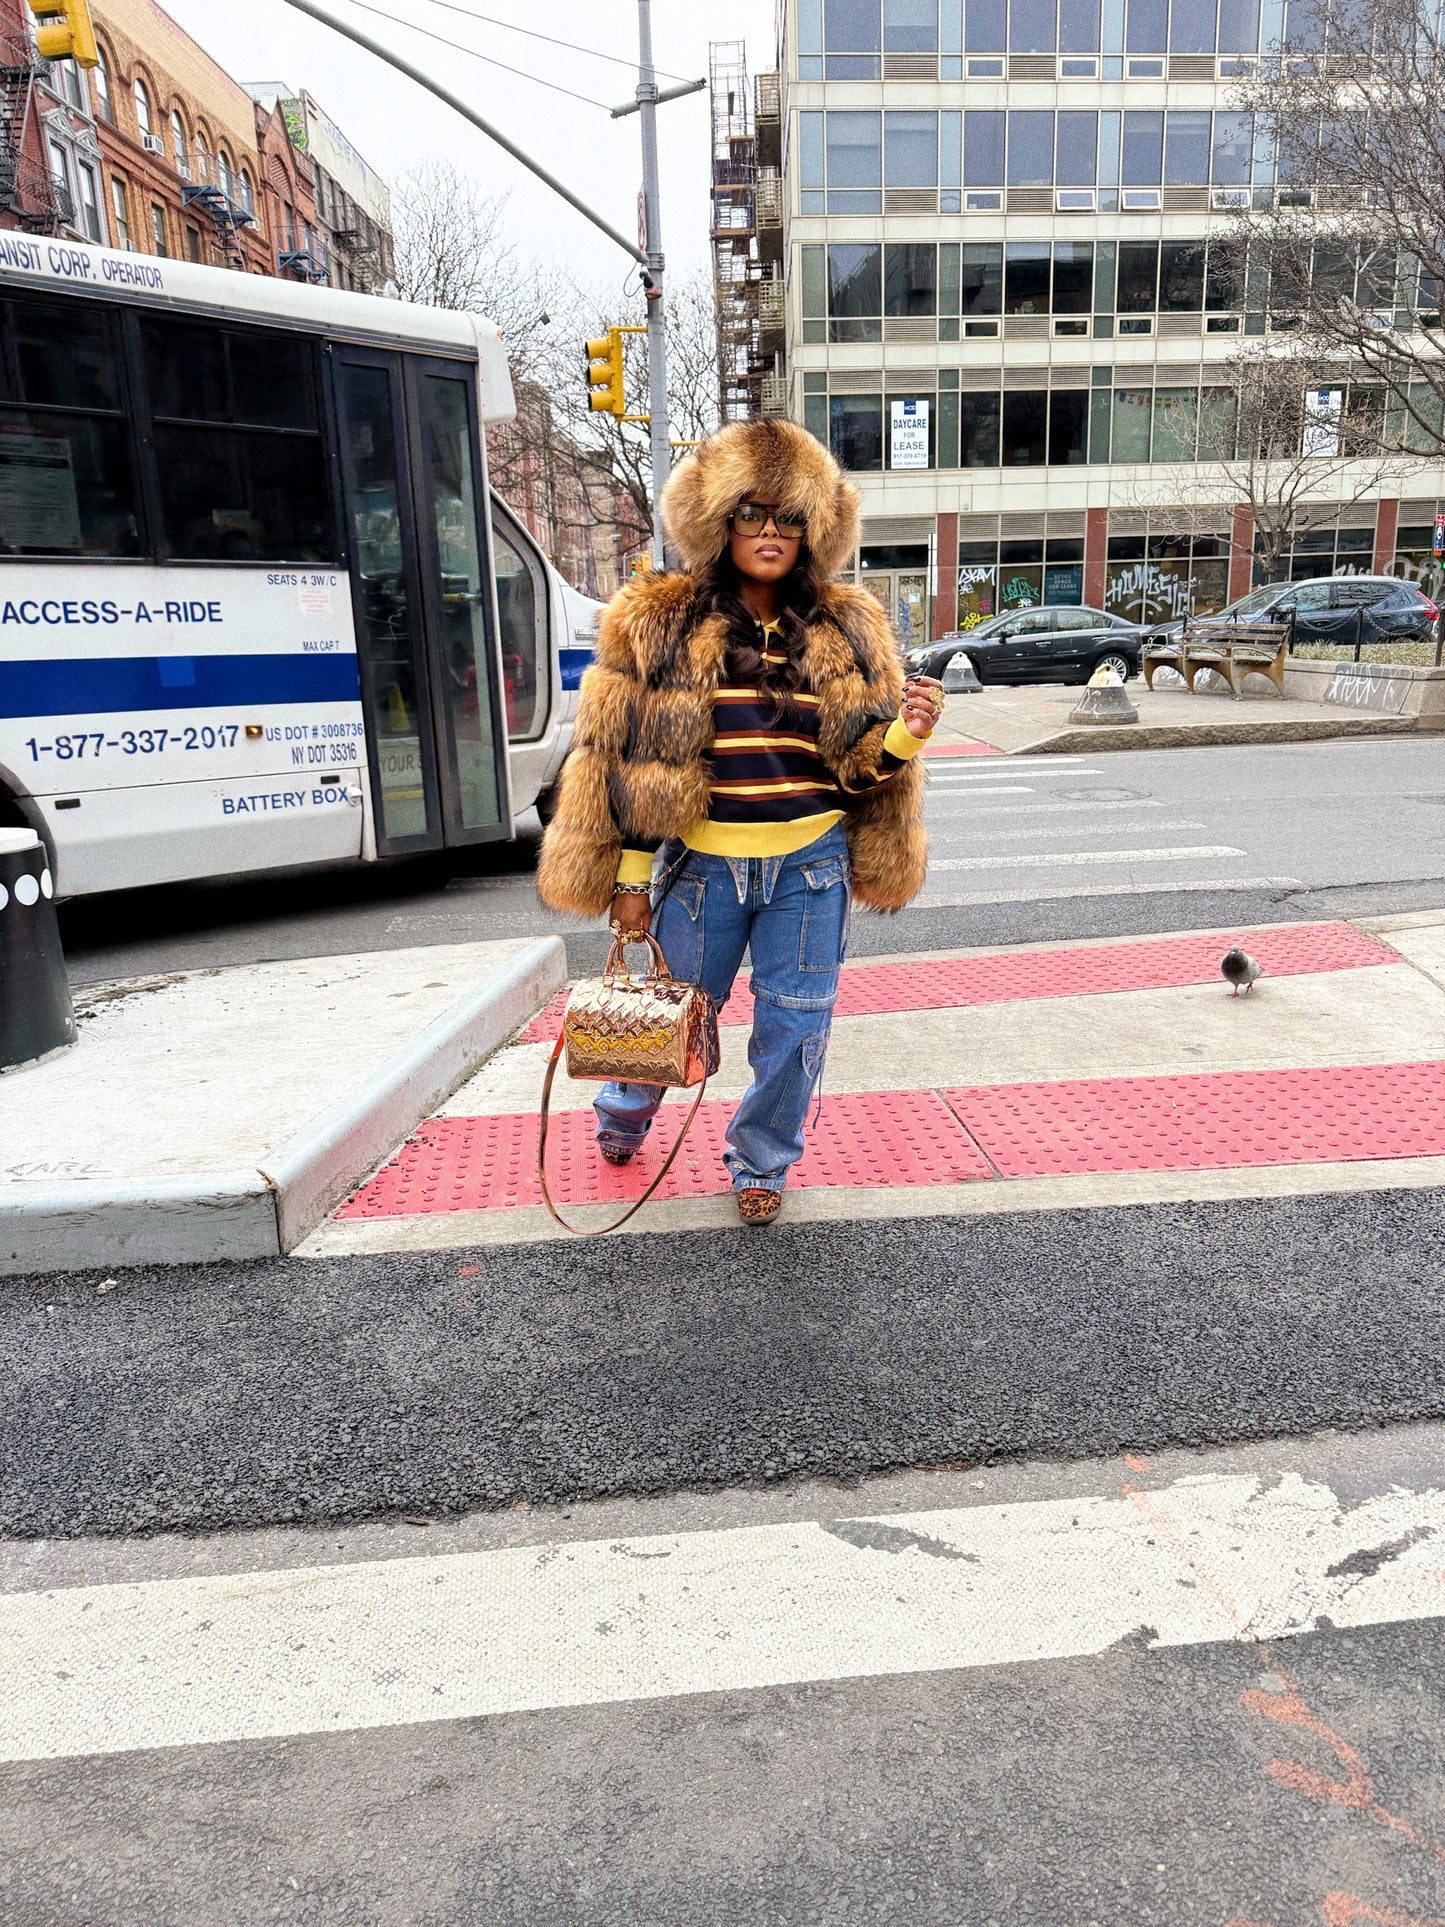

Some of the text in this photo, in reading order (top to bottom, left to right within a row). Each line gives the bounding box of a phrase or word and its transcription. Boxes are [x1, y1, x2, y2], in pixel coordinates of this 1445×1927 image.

[49, 246, 97, 280] CORP.
[101, 258, 164, 289] OPERATOR
[893, 418, 927, 430] DAYCARE
[903, 431, 916, 439] FOR
[893, 441, 925, 451] LEASE
[267, 574, 298, 586] SEATS
[301, 575, 307, 585] 4
[1, 600, 223, 624] ACCESS-A-RIDE
[303, 641, 318, 651] MAX
[320, 641, 333, 651] CAP
[25, 725, 239, 762] 1-877-337-2017
[265, 727, 281, 741] US
[285, 725, 309, 741] DOT
[291, 742, 357, 765] NY DOT 35316
[222, 787, 348, 815] BATTERY BOX
